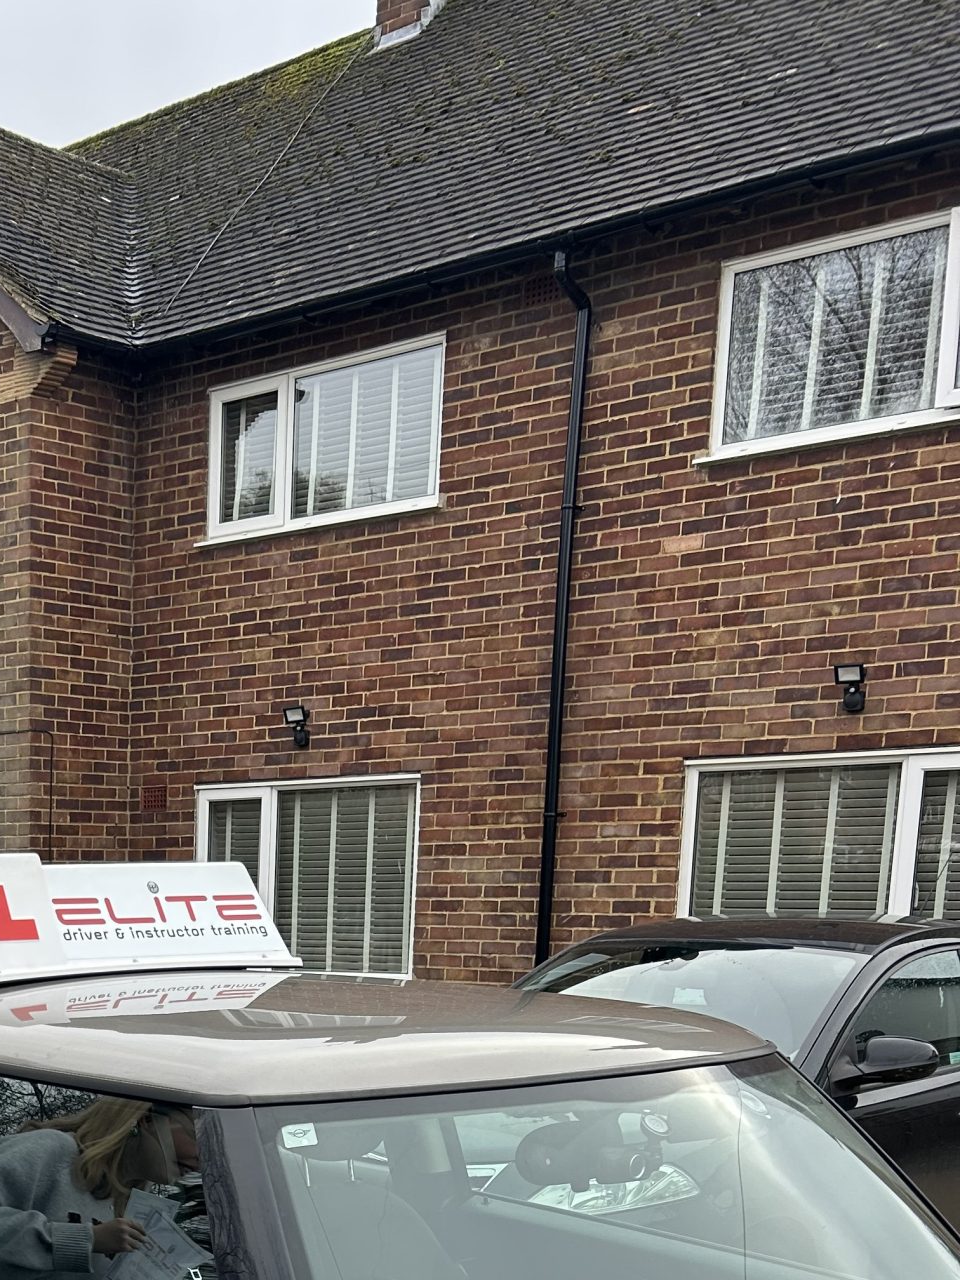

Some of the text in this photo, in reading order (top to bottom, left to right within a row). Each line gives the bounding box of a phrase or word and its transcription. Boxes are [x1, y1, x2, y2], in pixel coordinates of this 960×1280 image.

[63, 923, 268, 942] driver & instructor training
